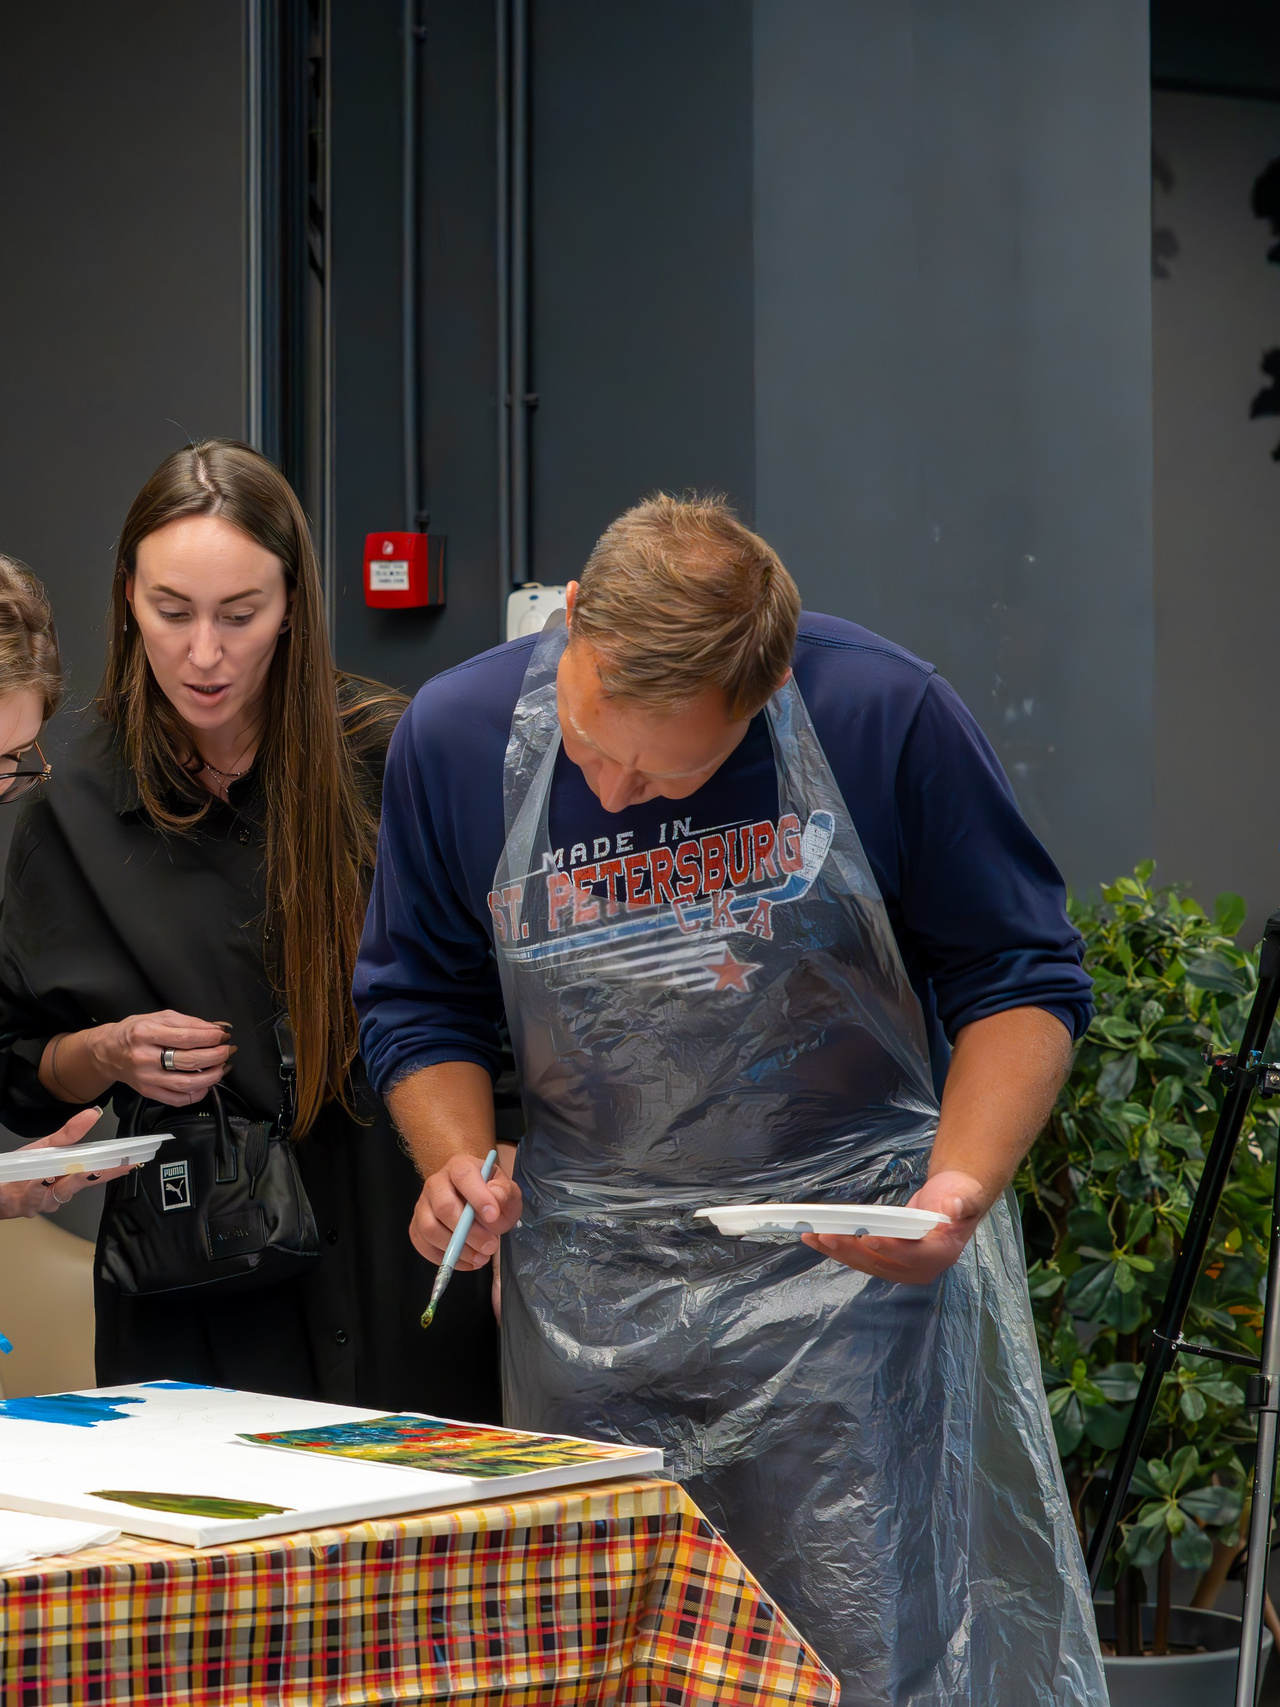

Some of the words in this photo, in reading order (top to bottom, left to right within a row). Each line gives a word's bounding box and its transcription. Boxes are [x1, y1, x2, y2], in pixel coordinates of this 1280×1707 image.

[542, 831, 634, 872] MADE
[659, 817, 692, 843] IN
[487, 885, 530, 941] ST.
[546, 813, 804, 932] PETERSBURG
[163, 1166, 184, 1178] PUMA
